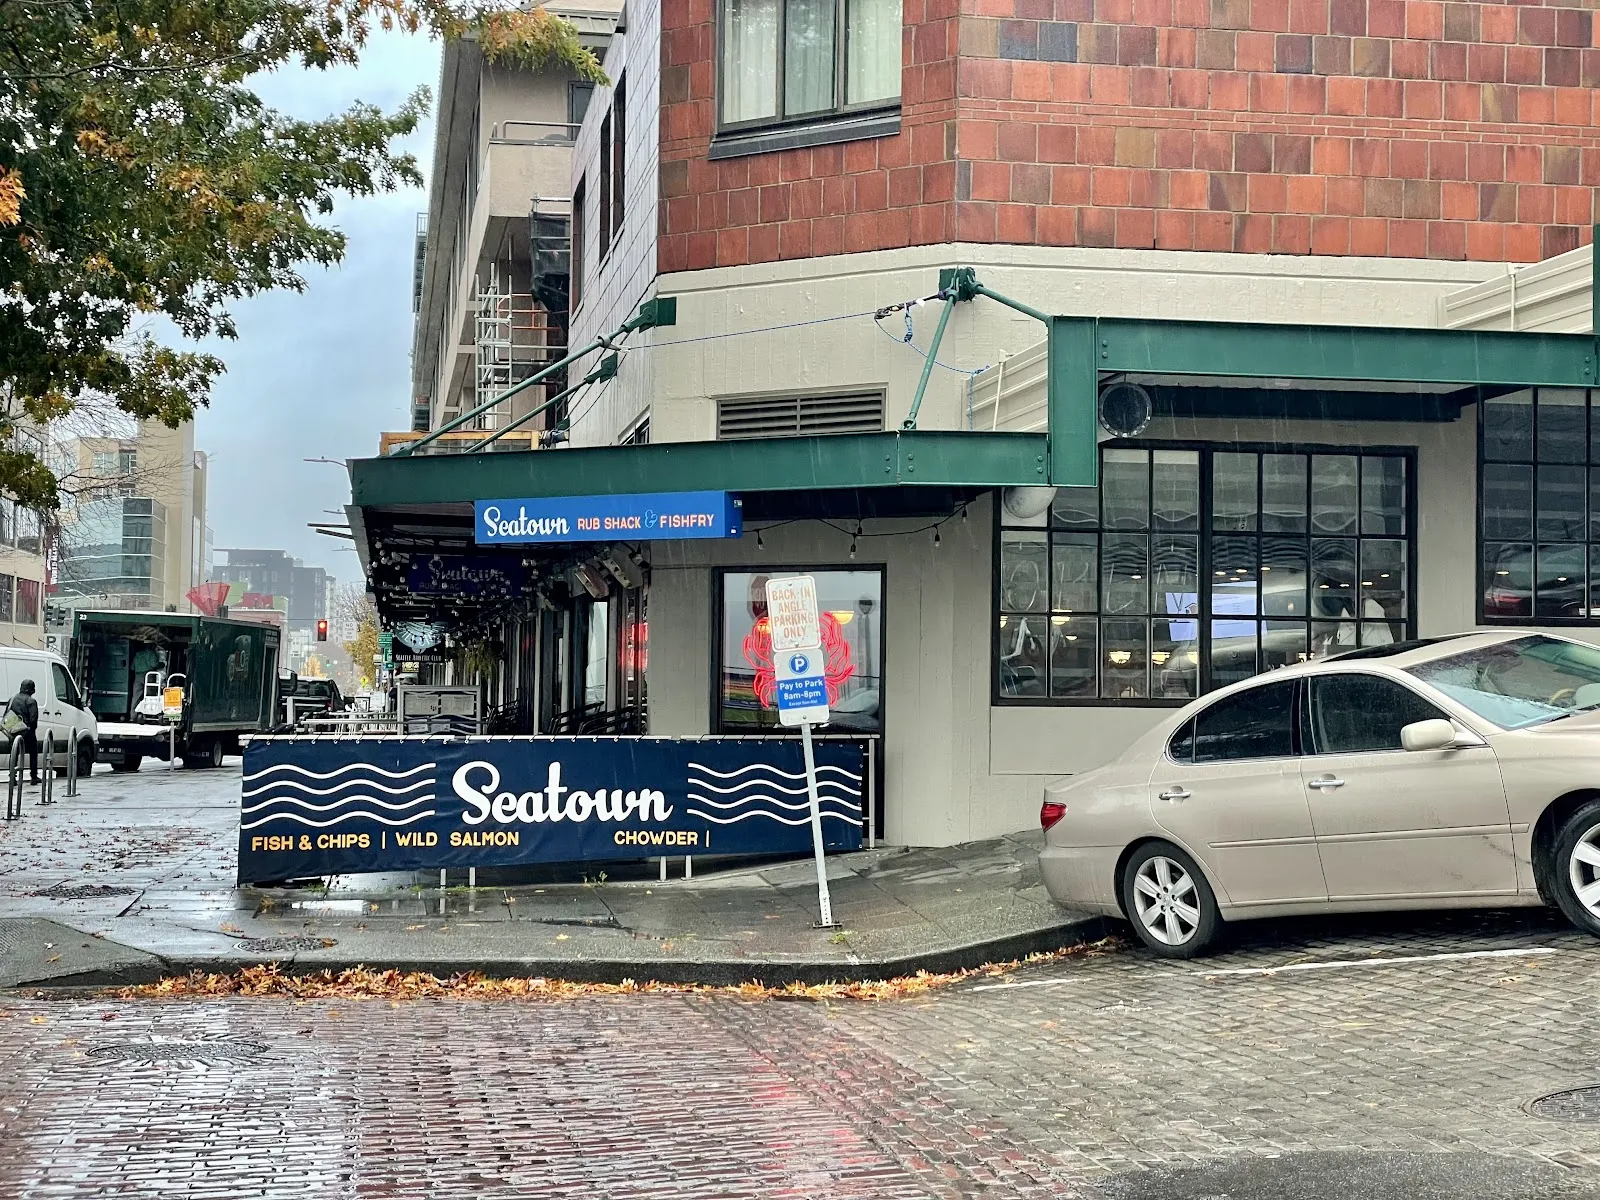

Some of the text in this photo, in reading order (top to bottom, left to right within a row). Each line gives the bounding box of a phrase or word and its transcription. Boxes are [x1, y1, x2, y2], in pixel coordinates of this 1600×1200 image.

[483, 505, 715, 537] Seatown RUB SHACK & FISHFRY
[778, 600, 808, 613] ANGLE
[773, 612, 814, 627] PARKING
[783, 626, 807, 639] ONLY
[779, 678, 823, 691] Pay to Park
[783, 690, 821, 700] 8am-8pm
[452, 760, 673, 824] Seatown
[251, 835, 293, 851] FISH
[298, 836, 312, 851] &
[317, 833, 370, 849] CHIPS
[395, 831, 438, 848] WILD
[449, 831, 519, 847] SALMON
[614, 830, 698, 846] CHOWDER
